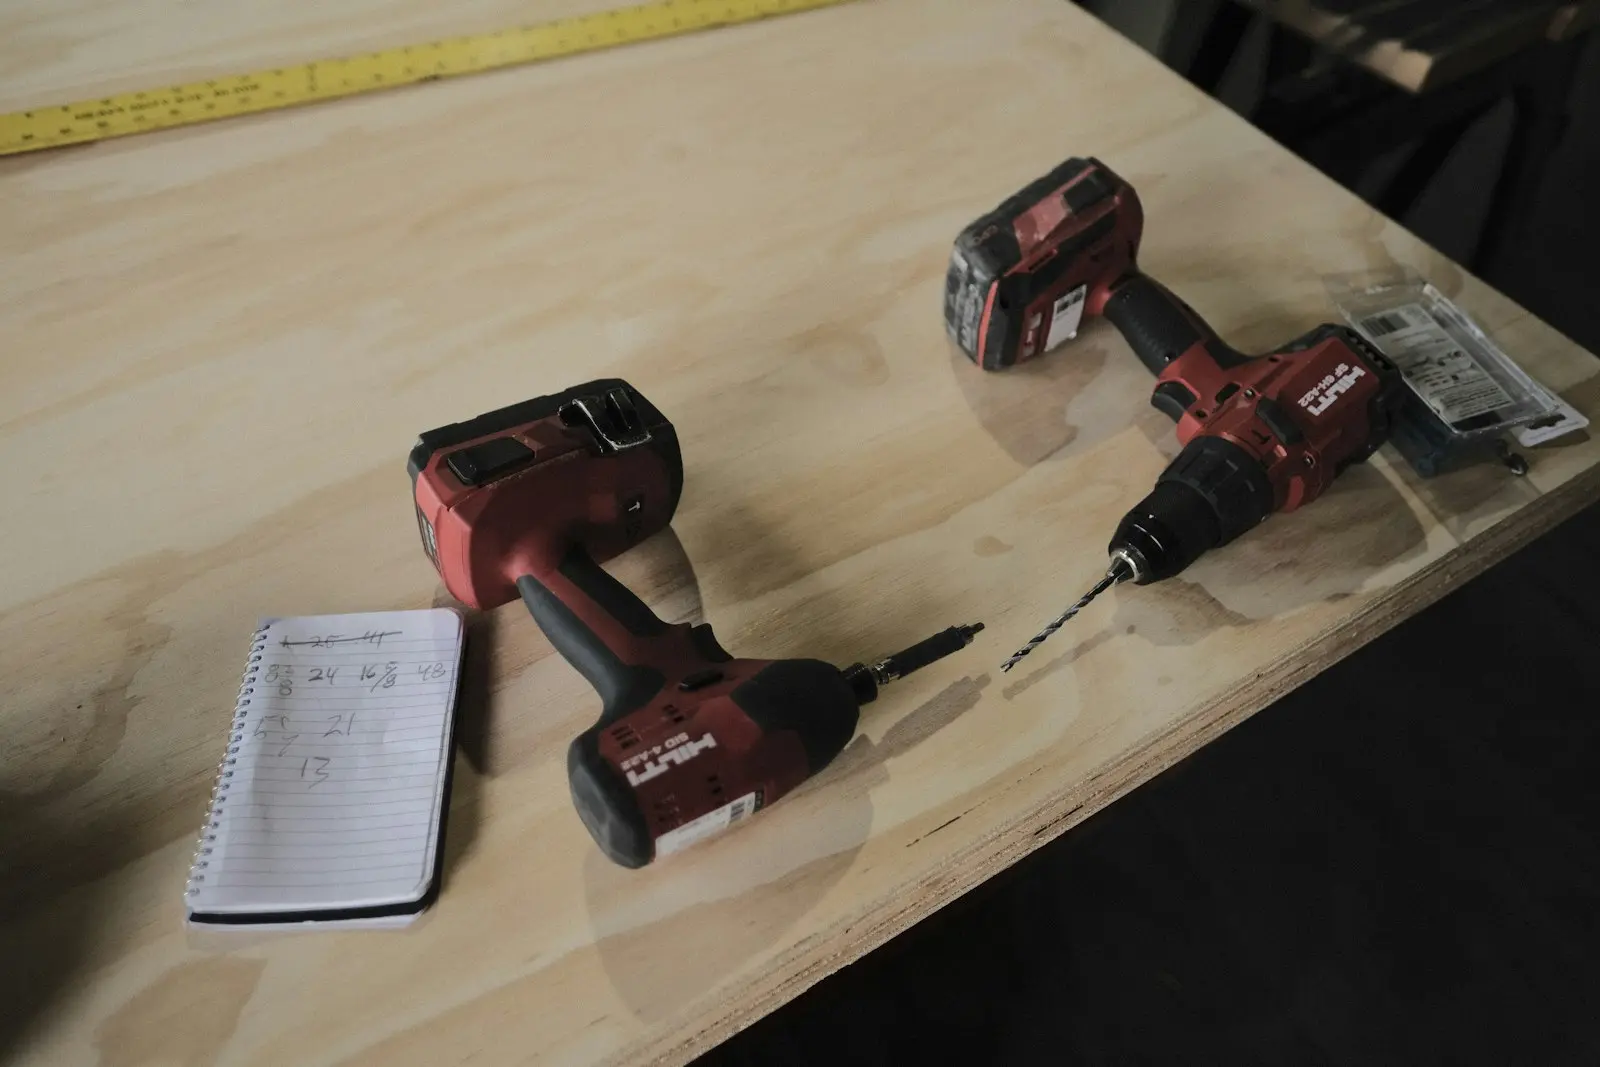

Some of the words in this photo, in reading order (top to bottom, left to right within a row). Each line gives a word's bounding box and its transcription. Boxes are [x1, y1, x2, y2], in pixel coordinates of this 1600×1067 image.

[1306, 365, 1366, 416] HILTI
[308, 668, 337, 685] 24
[626, 732, 718, 787] HILTI
